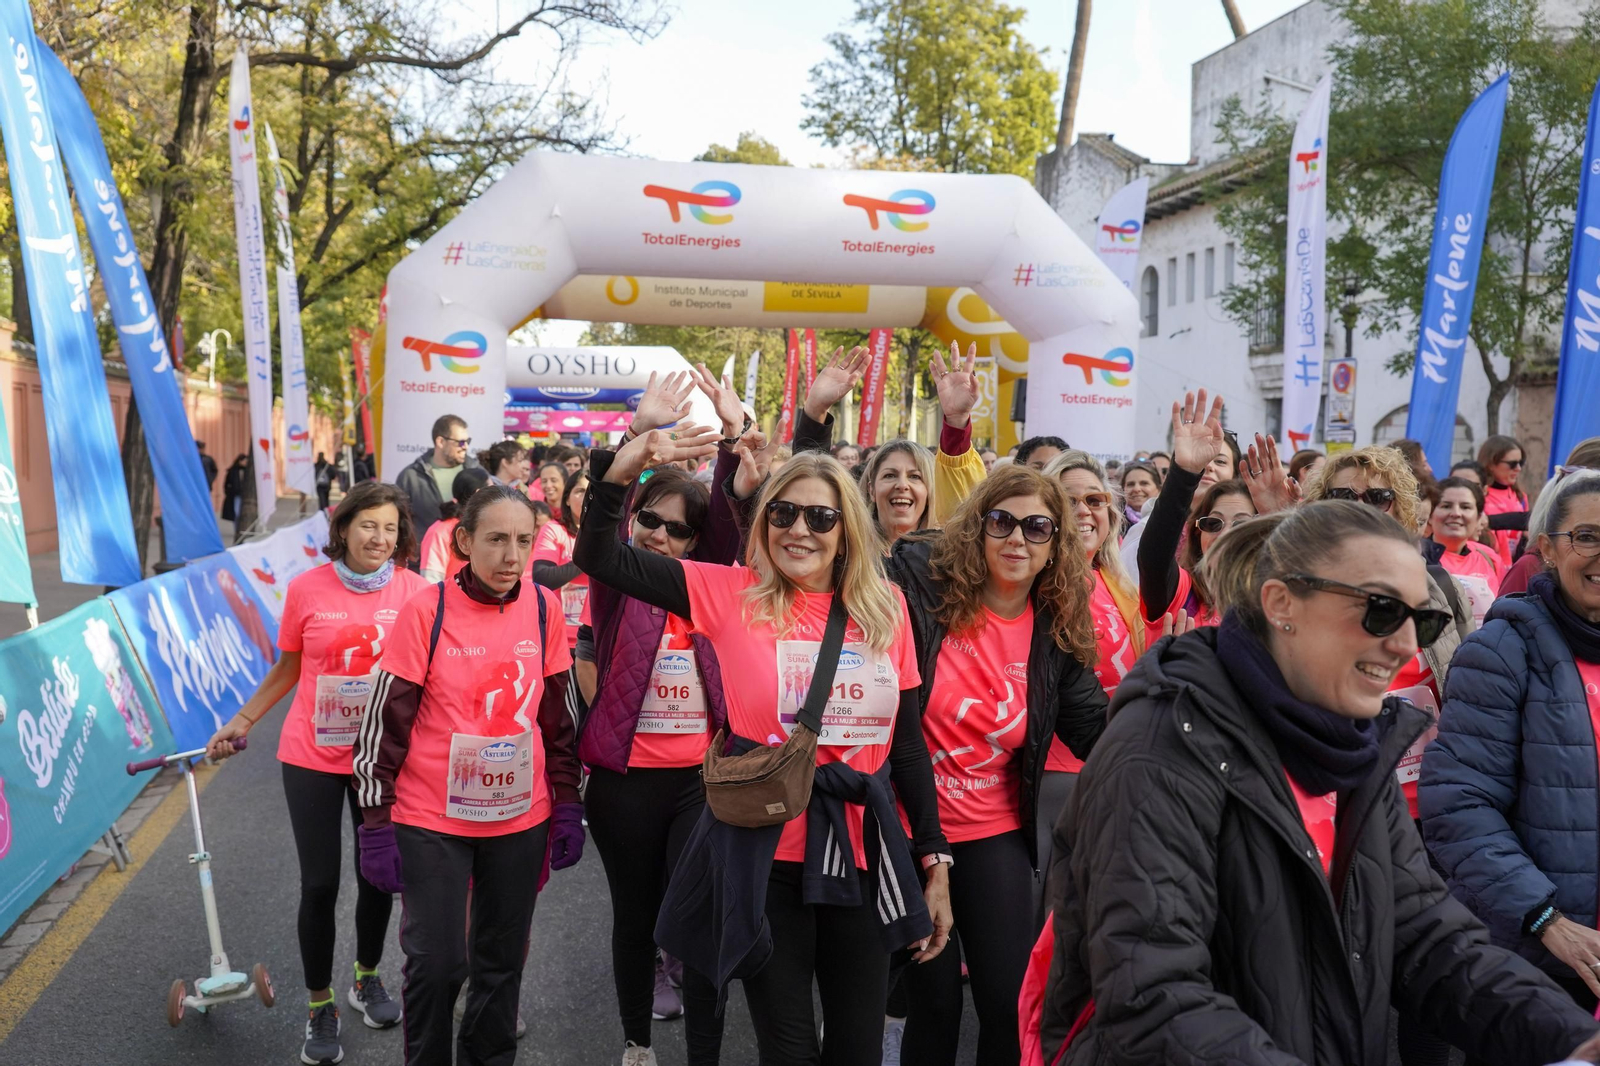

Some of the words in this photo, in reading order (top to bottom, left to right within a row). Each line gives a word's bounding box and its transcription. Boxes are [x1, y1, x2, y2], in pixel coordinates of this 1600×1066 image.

[642, 232, 741, 250] TotalEnergies
[842, 240, 935, 256] TotalEnergies
[466, 254, 546, 271] LasCarreras
[654, 284, 695, 296] Instituto
[699, 287, 748, 298] Municipal
[792, 289, 803, 298] DE
[807, 288, 841, 299] SEVILLA
[1420, 211, 1473, 384] Marlene
[669, 299, 682, 307] de
[686, 299, 732, 310] Deportes
[528, 353, 635, 376] OYSHO
[865, 330, 887, 403] Santander
[400, 381, 485, 397] TotalEnergies
[1060, 394, 1132, 408] TotalEnergies
[315, 612, 348, 620] OYSHO
[447, 647, 485, 656] OYSHO
[943, 635, 978, 657] YSHO
[657, 662, 689, 670] ASTURIANA
[657, 685, 690, 699] 016
[832, 707, 852, 715] 1266
[482, 772, 514, 787] 016
[947, 777, 960, 788] DE
[962, 779, 972, 790] LA
[974, 774, 1000, 790] MUJER
[947, 790, 964, 799] 2025
[457, 807, 488, 817] OYSHO
